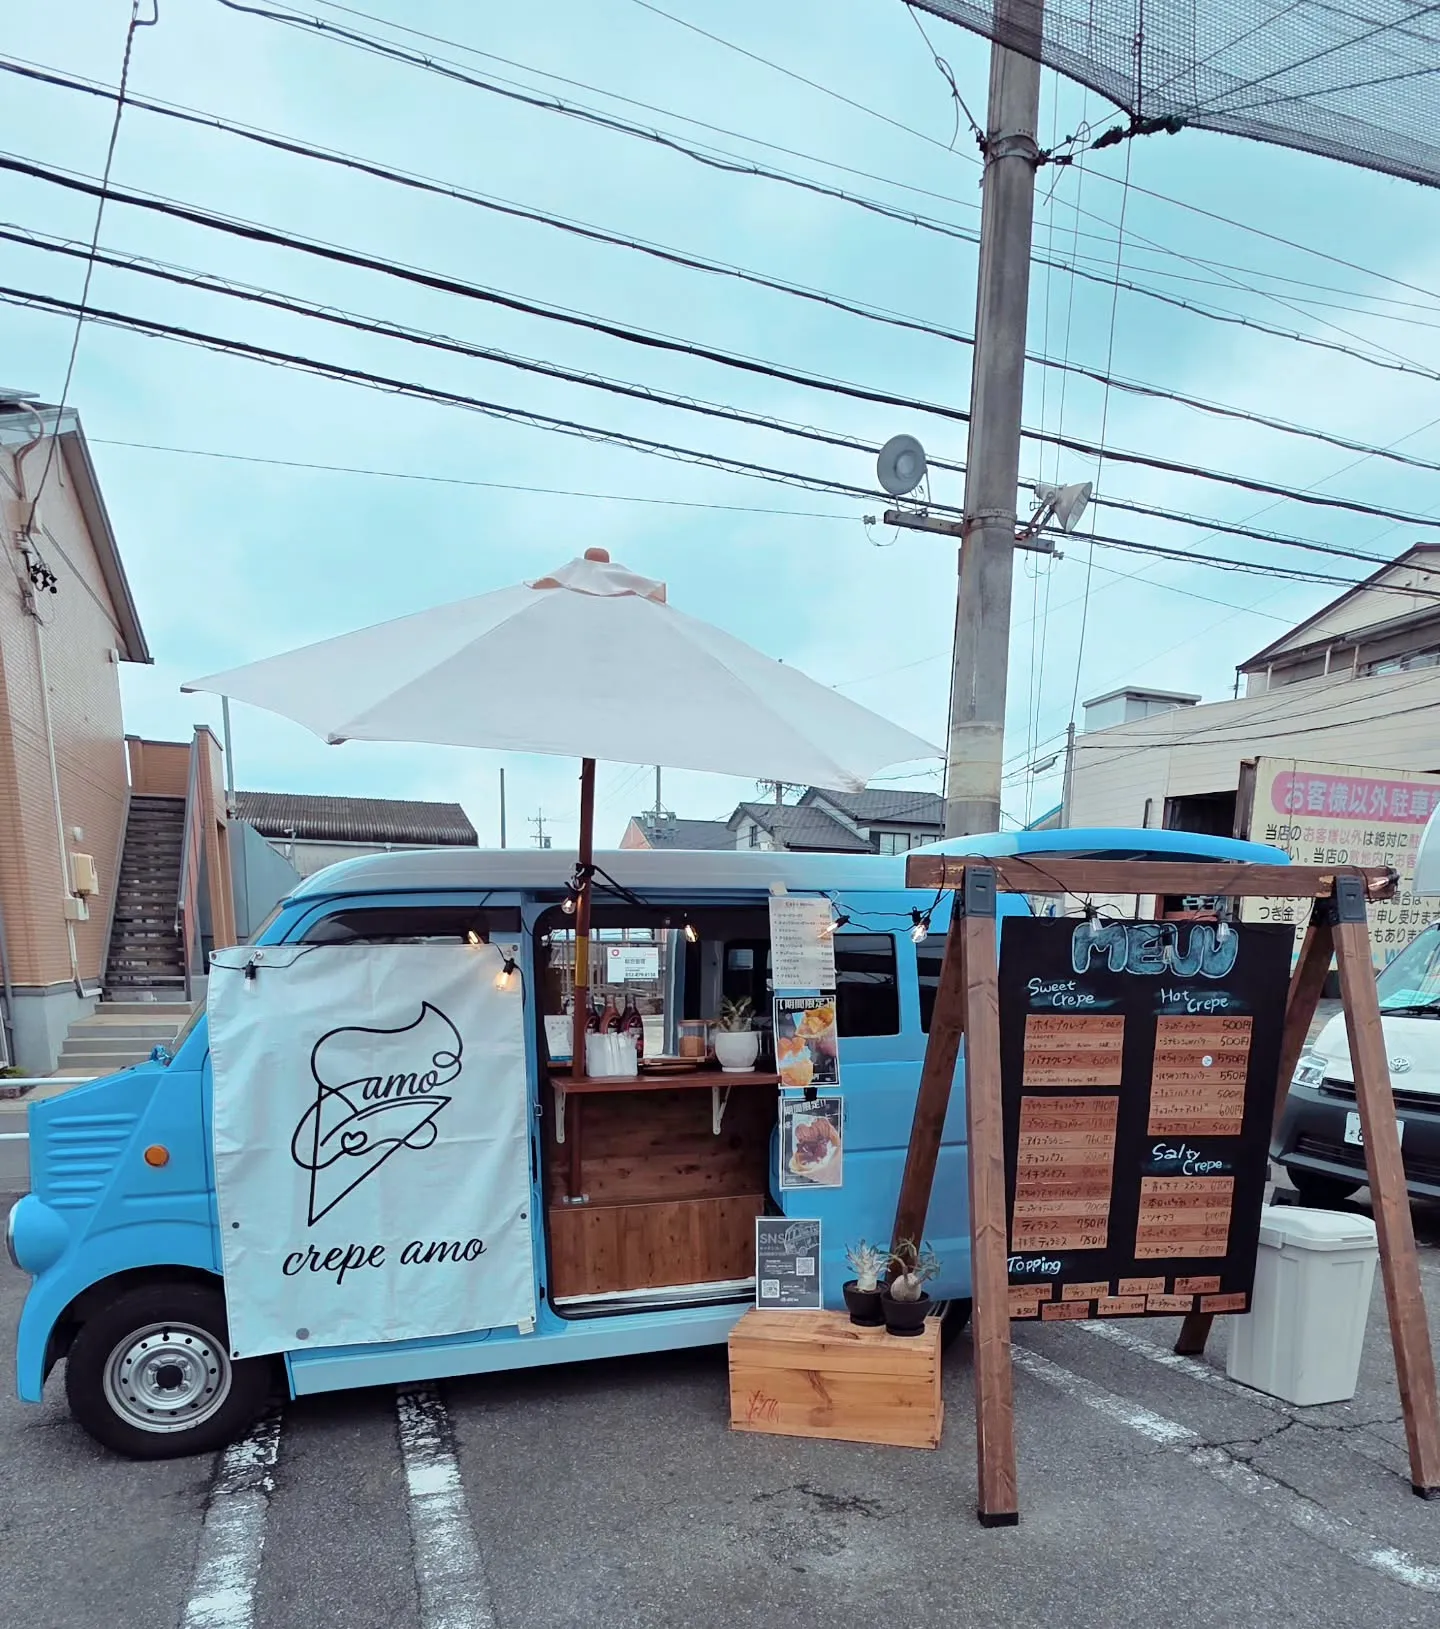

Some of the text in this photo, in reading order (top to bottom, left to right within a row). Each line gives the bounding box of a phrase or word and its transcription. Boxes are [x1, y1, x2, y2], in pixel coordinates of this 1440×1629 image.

[1027, 977, 1076, 996] Sweet
[1052, 991, 1095, 1008] Crepe
[1161, 988, 1190, 1003] Hot
[1186, 995, 1230, 1013] Crepe
[1221, 1019, 1251, 1031] 500円
[1220, 1036, 1249, 1047] 500円
[362, 1069, 439, 1101] amo
[1152, 1143, 1201, 1161] Salty
[1182, 1159, 1223, 1176] Crepe
[1022, 1220, 1060, 1232] ティラミス
[760, 1233, 785, 1245] SNS
[282, 1236, 487, 1285] crepe amo
[1008, 1256, 1062, 1275] Topping
